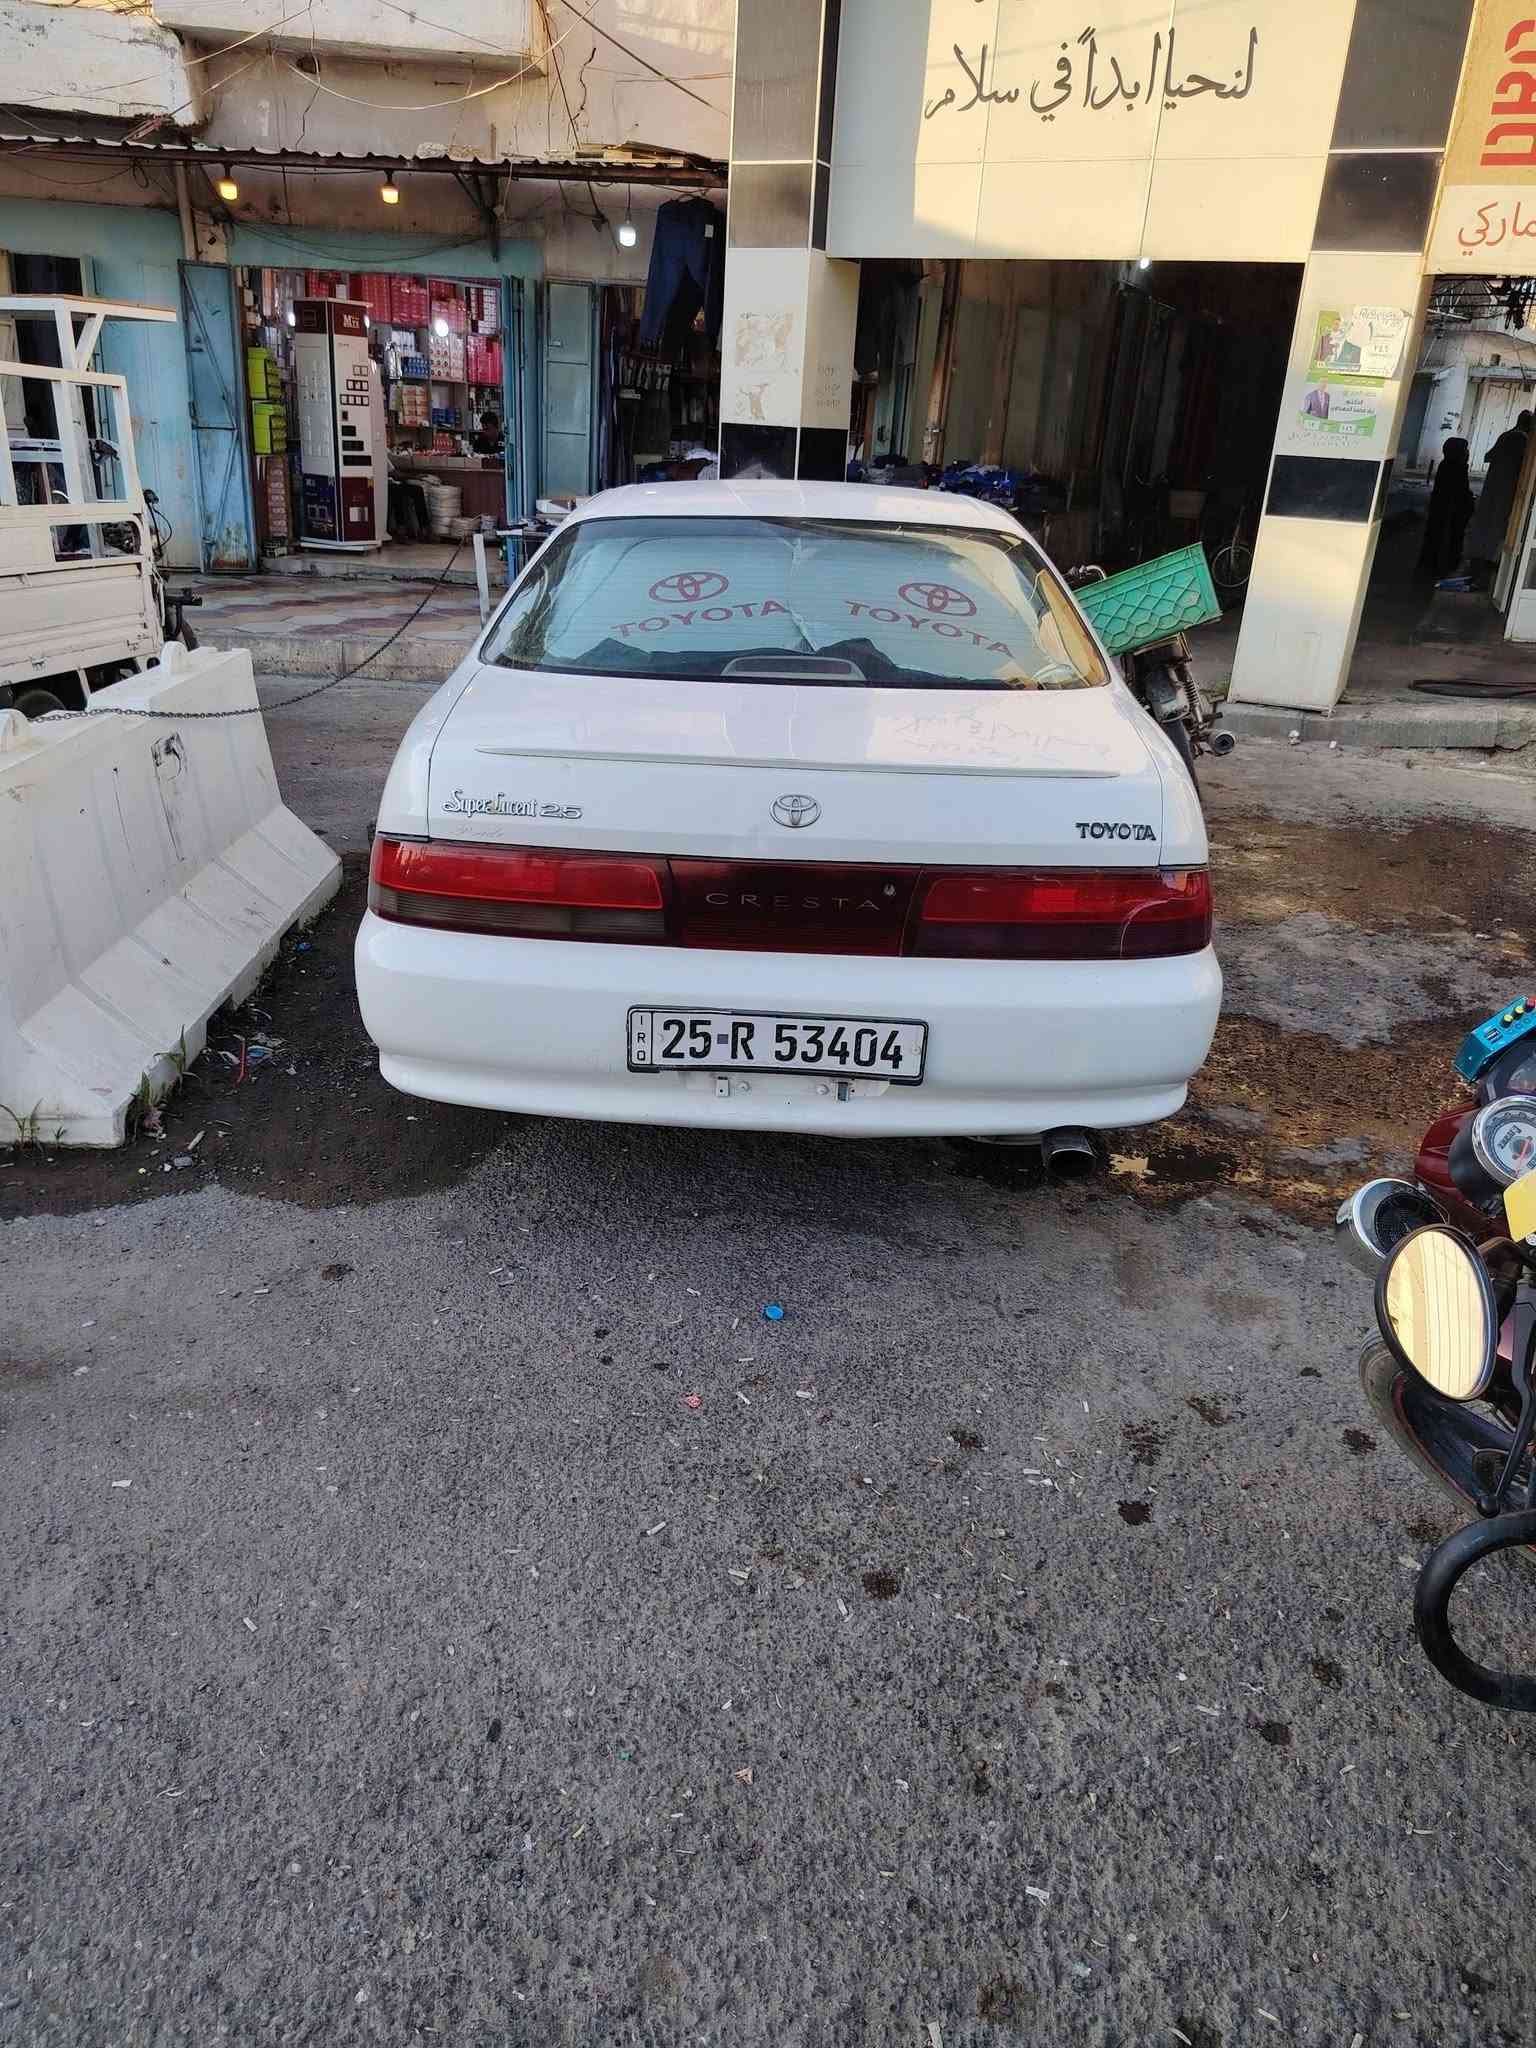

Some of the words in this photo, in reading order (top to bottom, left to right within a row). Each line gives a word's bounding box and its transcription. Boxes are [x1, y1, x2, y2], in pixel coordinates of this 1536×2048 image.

[924, 43, 1020, 119] سلام
[1029, 41, 1073, 122] في
[1163, 26, 1259, 111] لنحيا
[610, 600, 788, 638] TOYOTA
[844, 600, 1017, 659] TOYOTA
[441, 789, 492, 817] Super
[1075, 822, 1157, 841] TOYOTA
[705, 892, 881, 912] CRESTA
[774, 1024, 903, 1069] 53404
